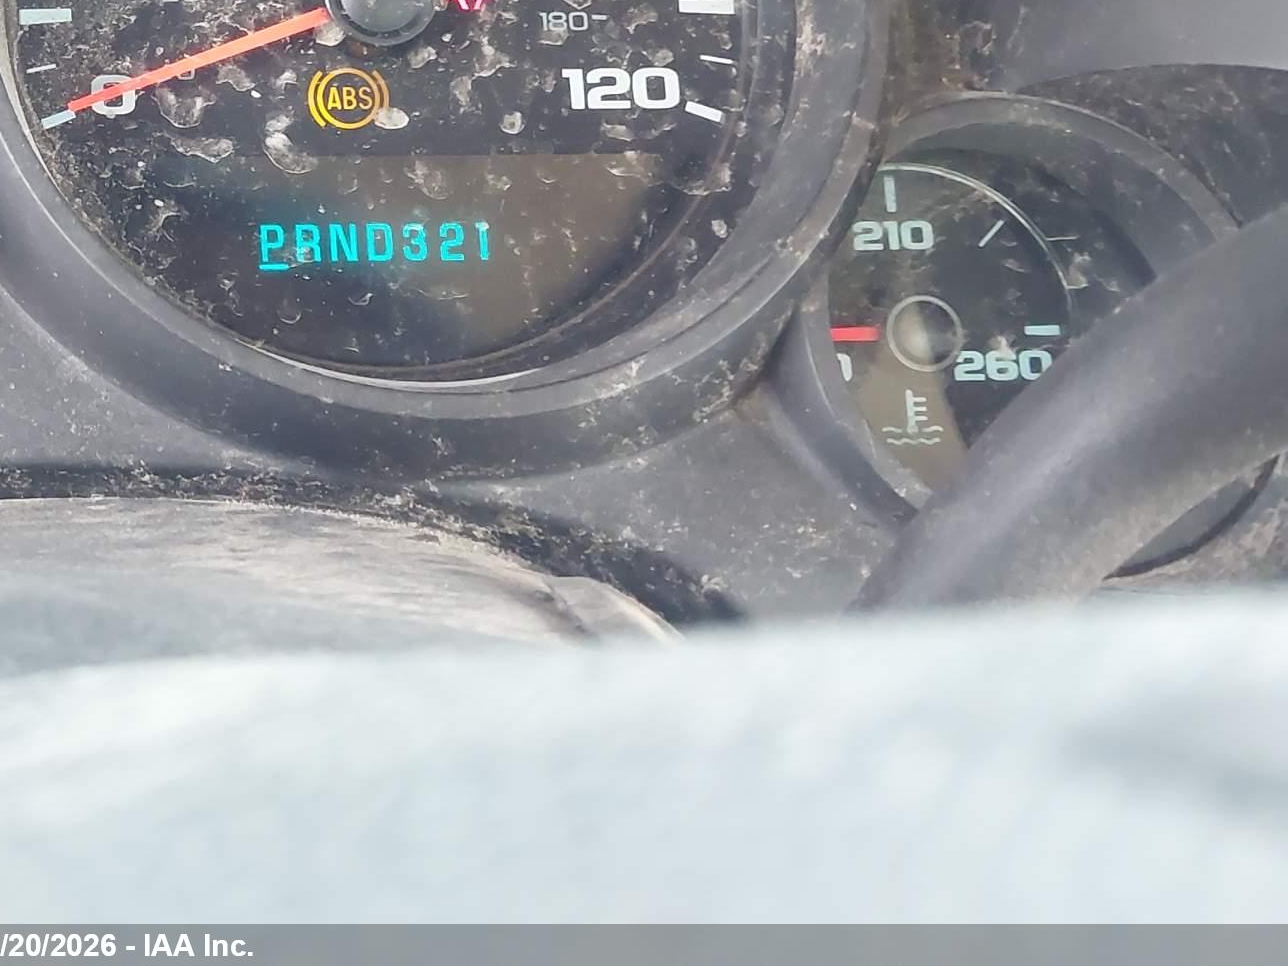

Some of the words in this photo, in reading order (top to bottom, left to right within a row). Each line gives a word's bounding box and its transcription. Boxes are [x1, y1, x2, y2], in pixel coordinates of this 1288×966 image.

[539, 11, 589, 32] 180
[91, 74, 137, 115] 0
[327, 86, 373, 111] ABS
[561, 68, 681, 112] 120
[259, 221, 490, 263] PRND321
[852, 220, 935, 251] 210
[954, 350, 1053, 382] 260
